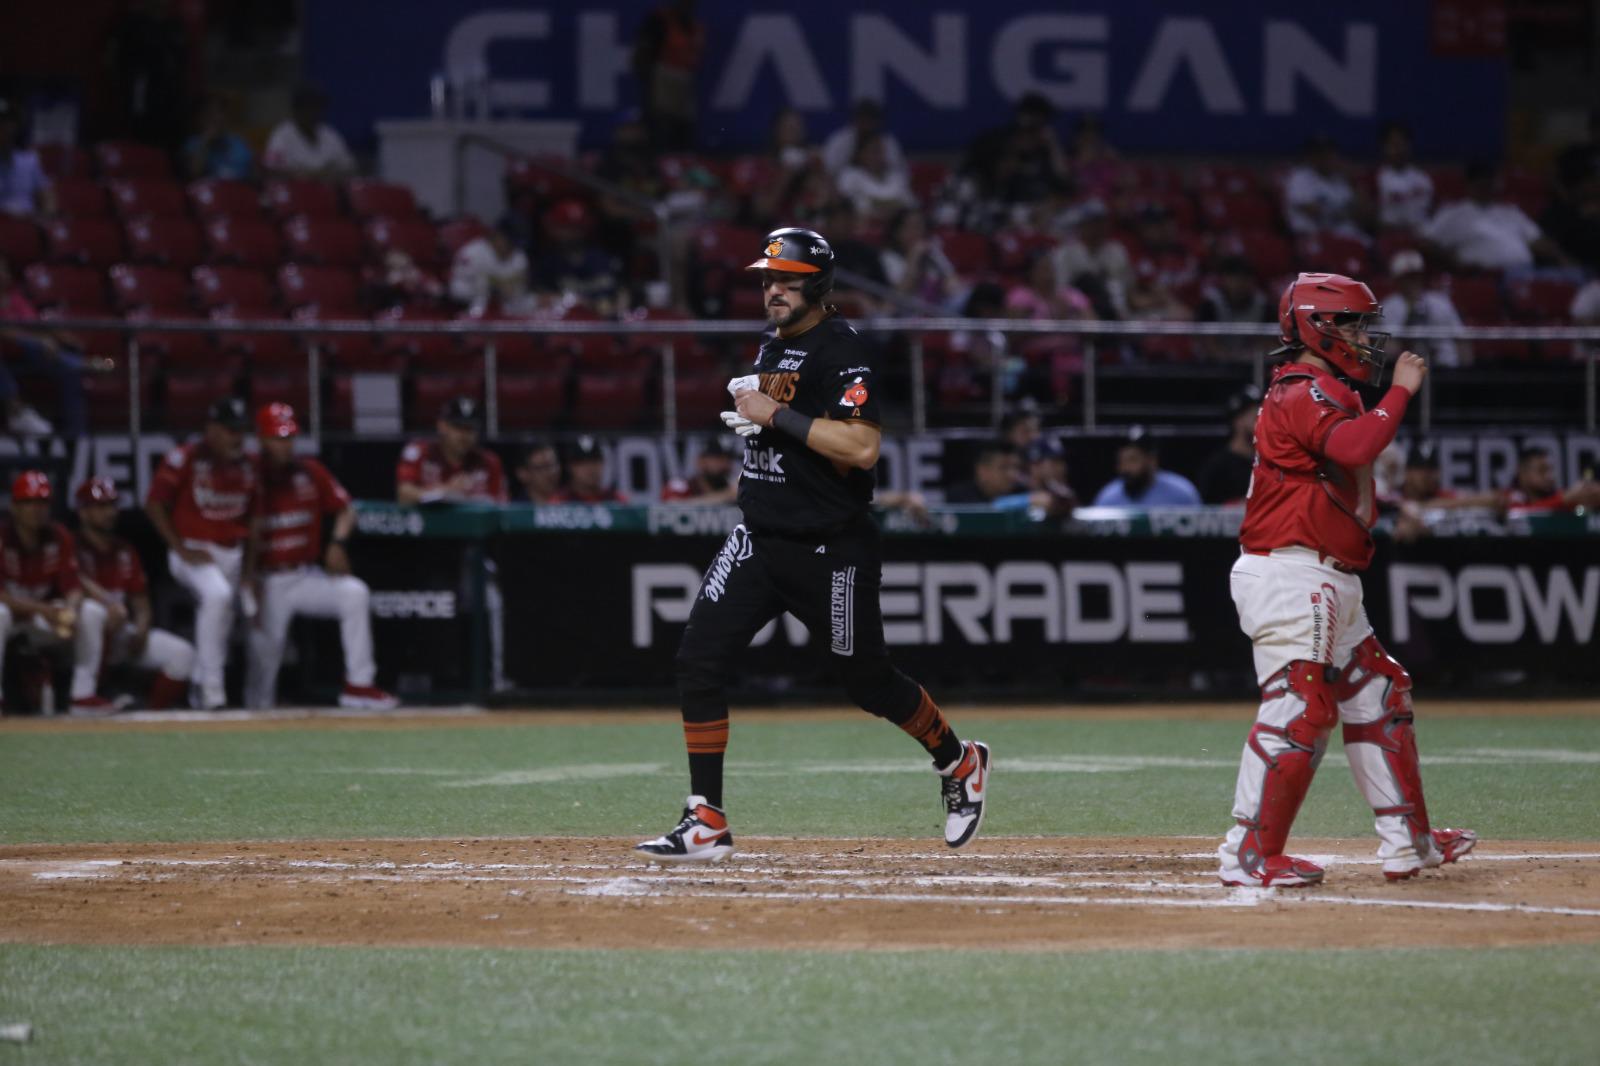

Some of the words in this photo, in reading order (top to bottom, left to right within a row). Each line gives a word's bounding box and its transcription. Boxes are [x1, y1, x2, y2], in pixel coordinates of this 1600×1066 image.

[446, 11, 1377, 117] CHANGAN
[633, 562, 1189, 647] PERADE
[831, 570, 847, 647] PAQUETEXPRESS
